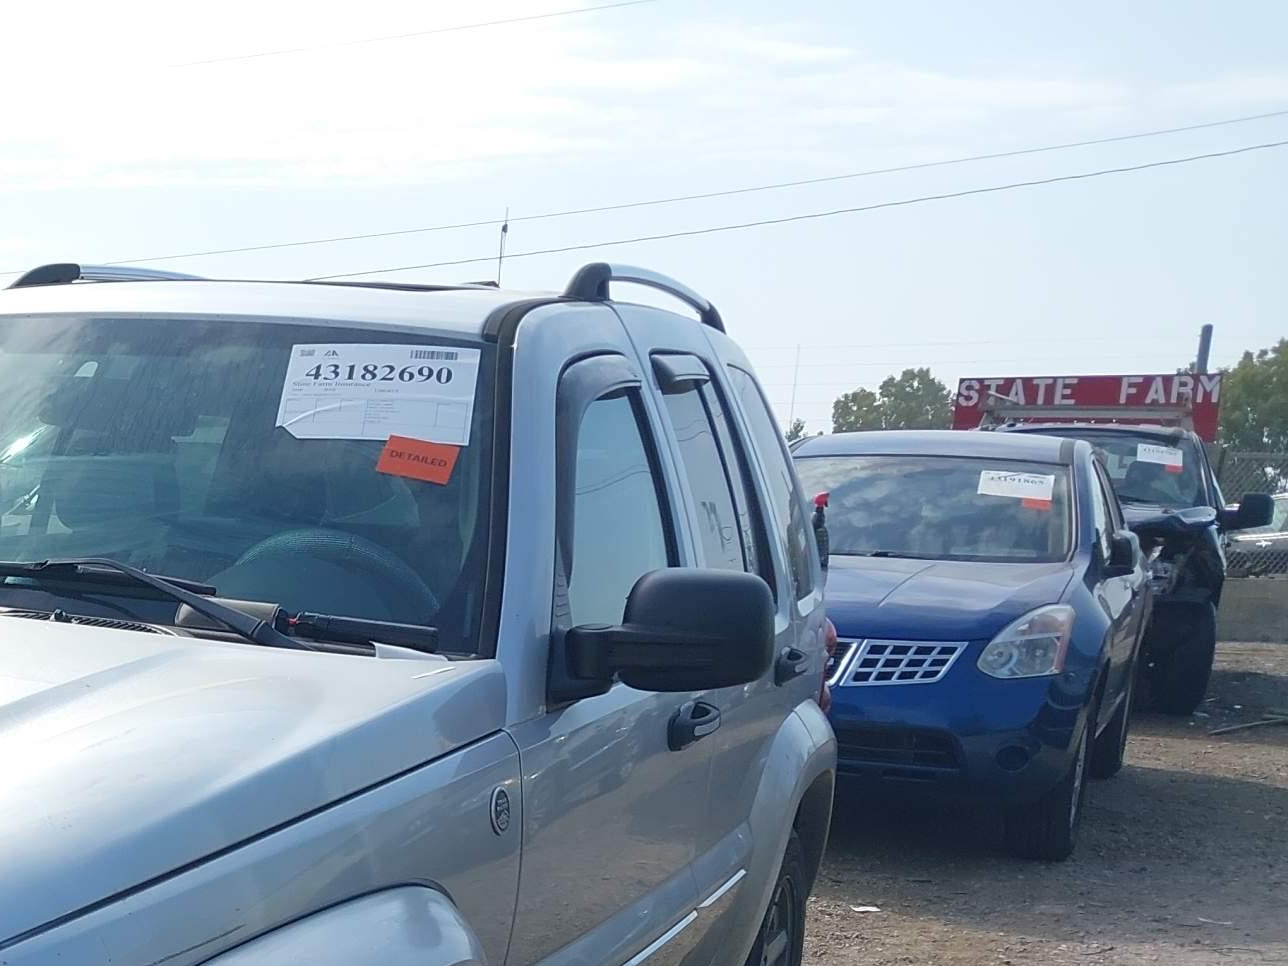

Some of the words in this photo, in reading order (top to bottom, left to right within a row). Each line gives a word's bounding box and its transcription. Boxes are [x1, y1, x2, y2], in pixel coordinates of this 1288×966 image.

[305, 363, 453, 385] 43182690
[958, 378, 1079, 407] STATE
[1119, 375, 1222, 405] FARM
[389, 449, 448, 468] DETAILED
